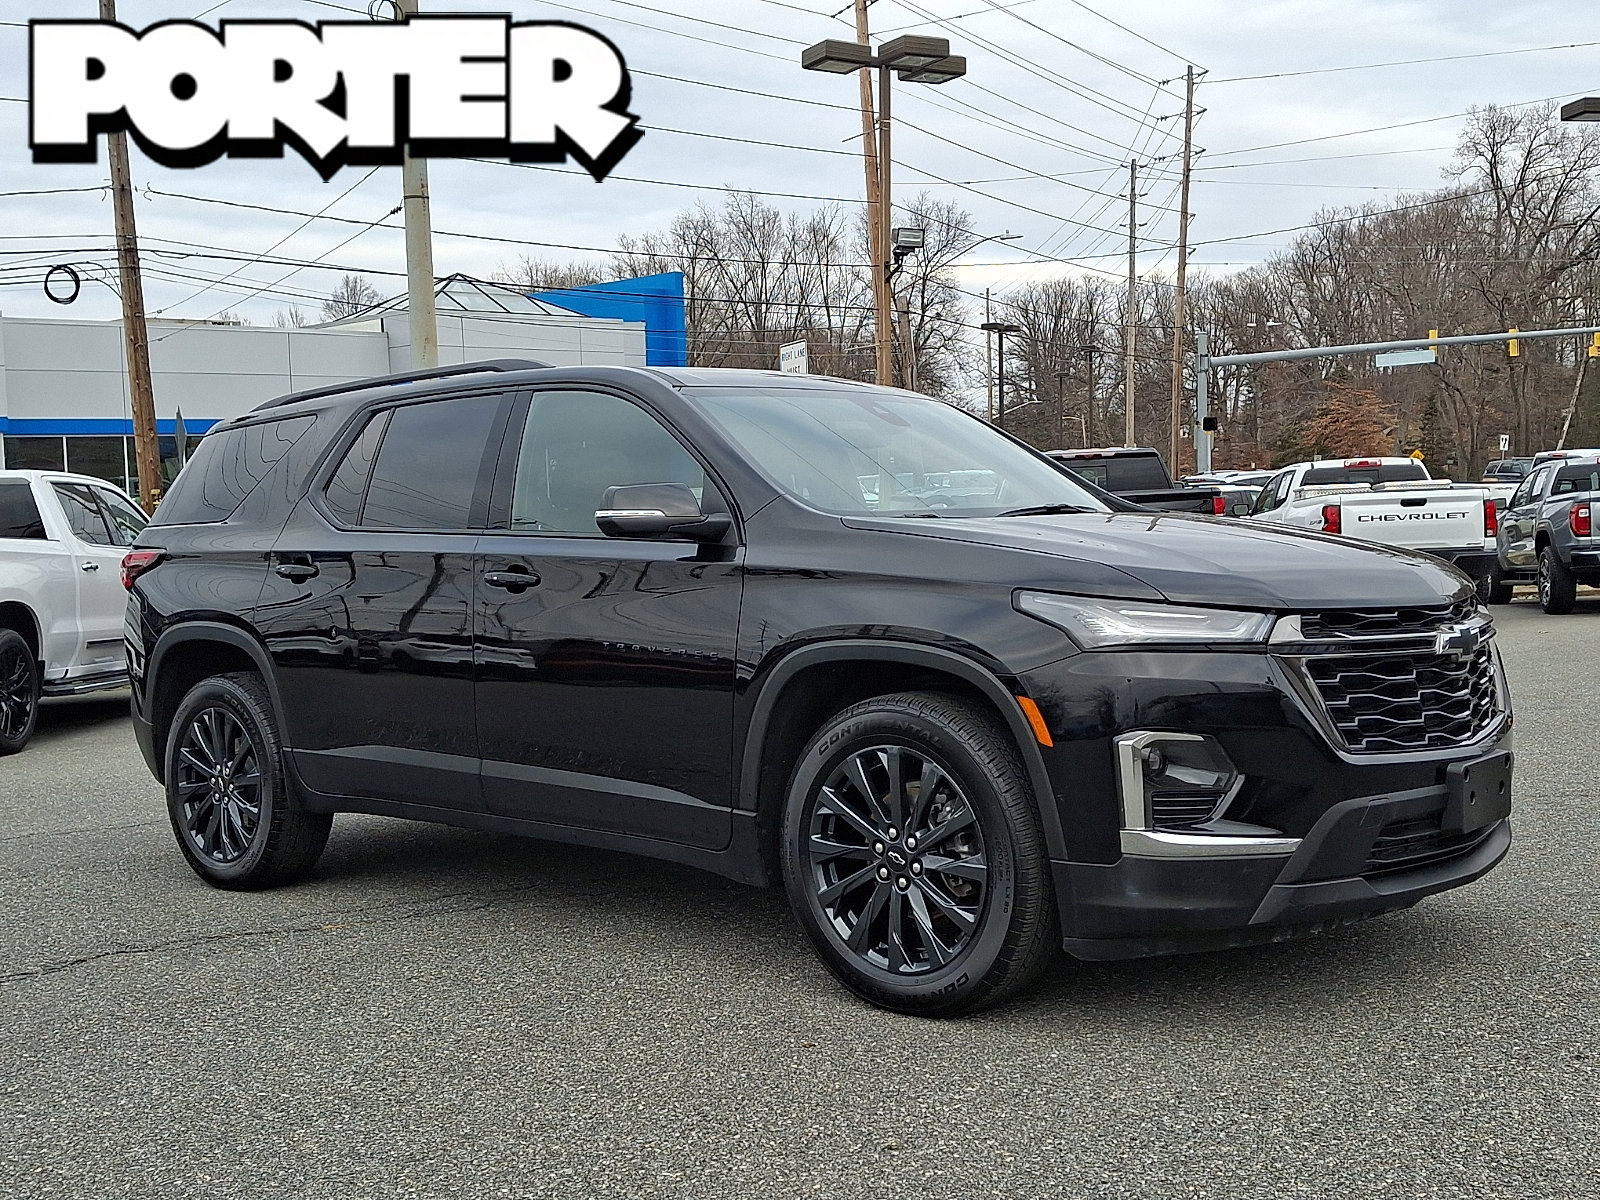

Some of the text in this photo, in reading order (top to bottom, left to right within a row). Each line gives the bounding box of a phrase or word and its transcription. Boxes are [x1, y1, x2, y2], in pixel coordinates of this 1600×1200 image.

[781, 347, 805, 361] RIGHT LANE
[1358, 511, 1469, 523] CHEVROLET
[602, 641, 720, 661] TRAVERSE
[818, 720, 943, 756] CONTNTAL
